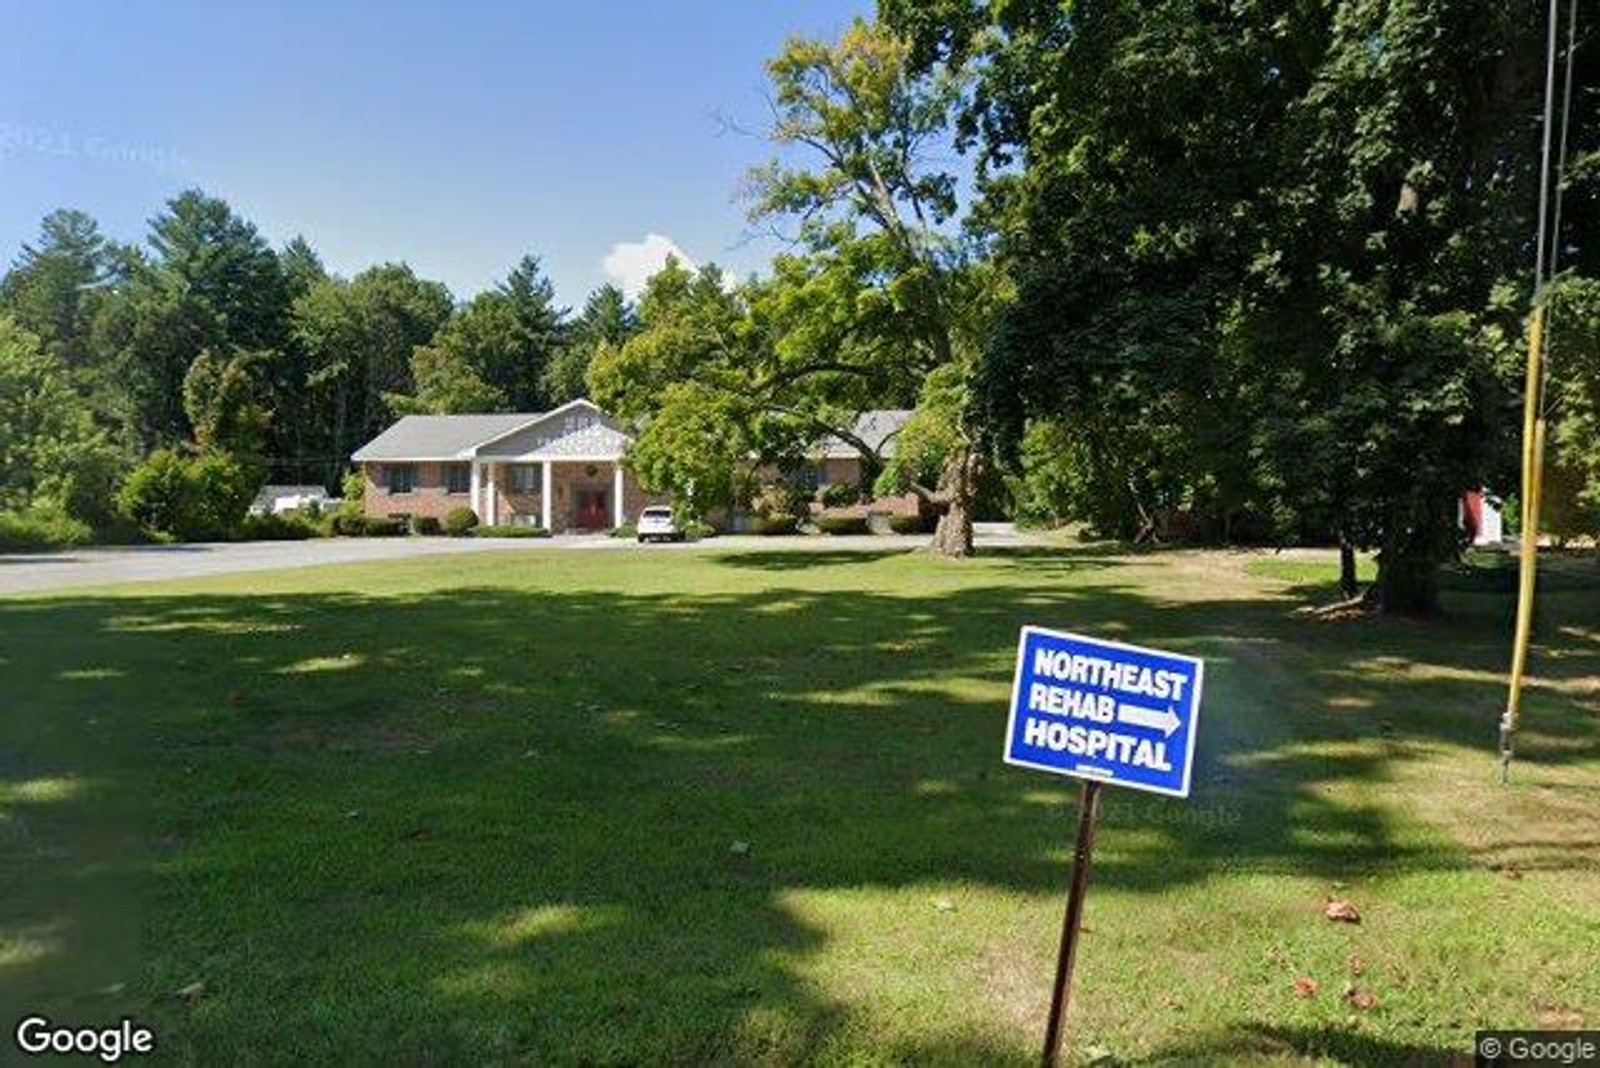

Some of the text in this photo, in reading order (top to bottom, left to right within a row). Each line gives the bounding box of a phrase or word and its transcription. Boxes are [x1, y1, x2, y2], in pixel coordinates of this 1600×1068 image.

[1034, 648, 1188, 700] NORTHEAST
[1029, 682, 1116, 723] REHAB
[1024, 718, 1171, 771] HOSPITAL
